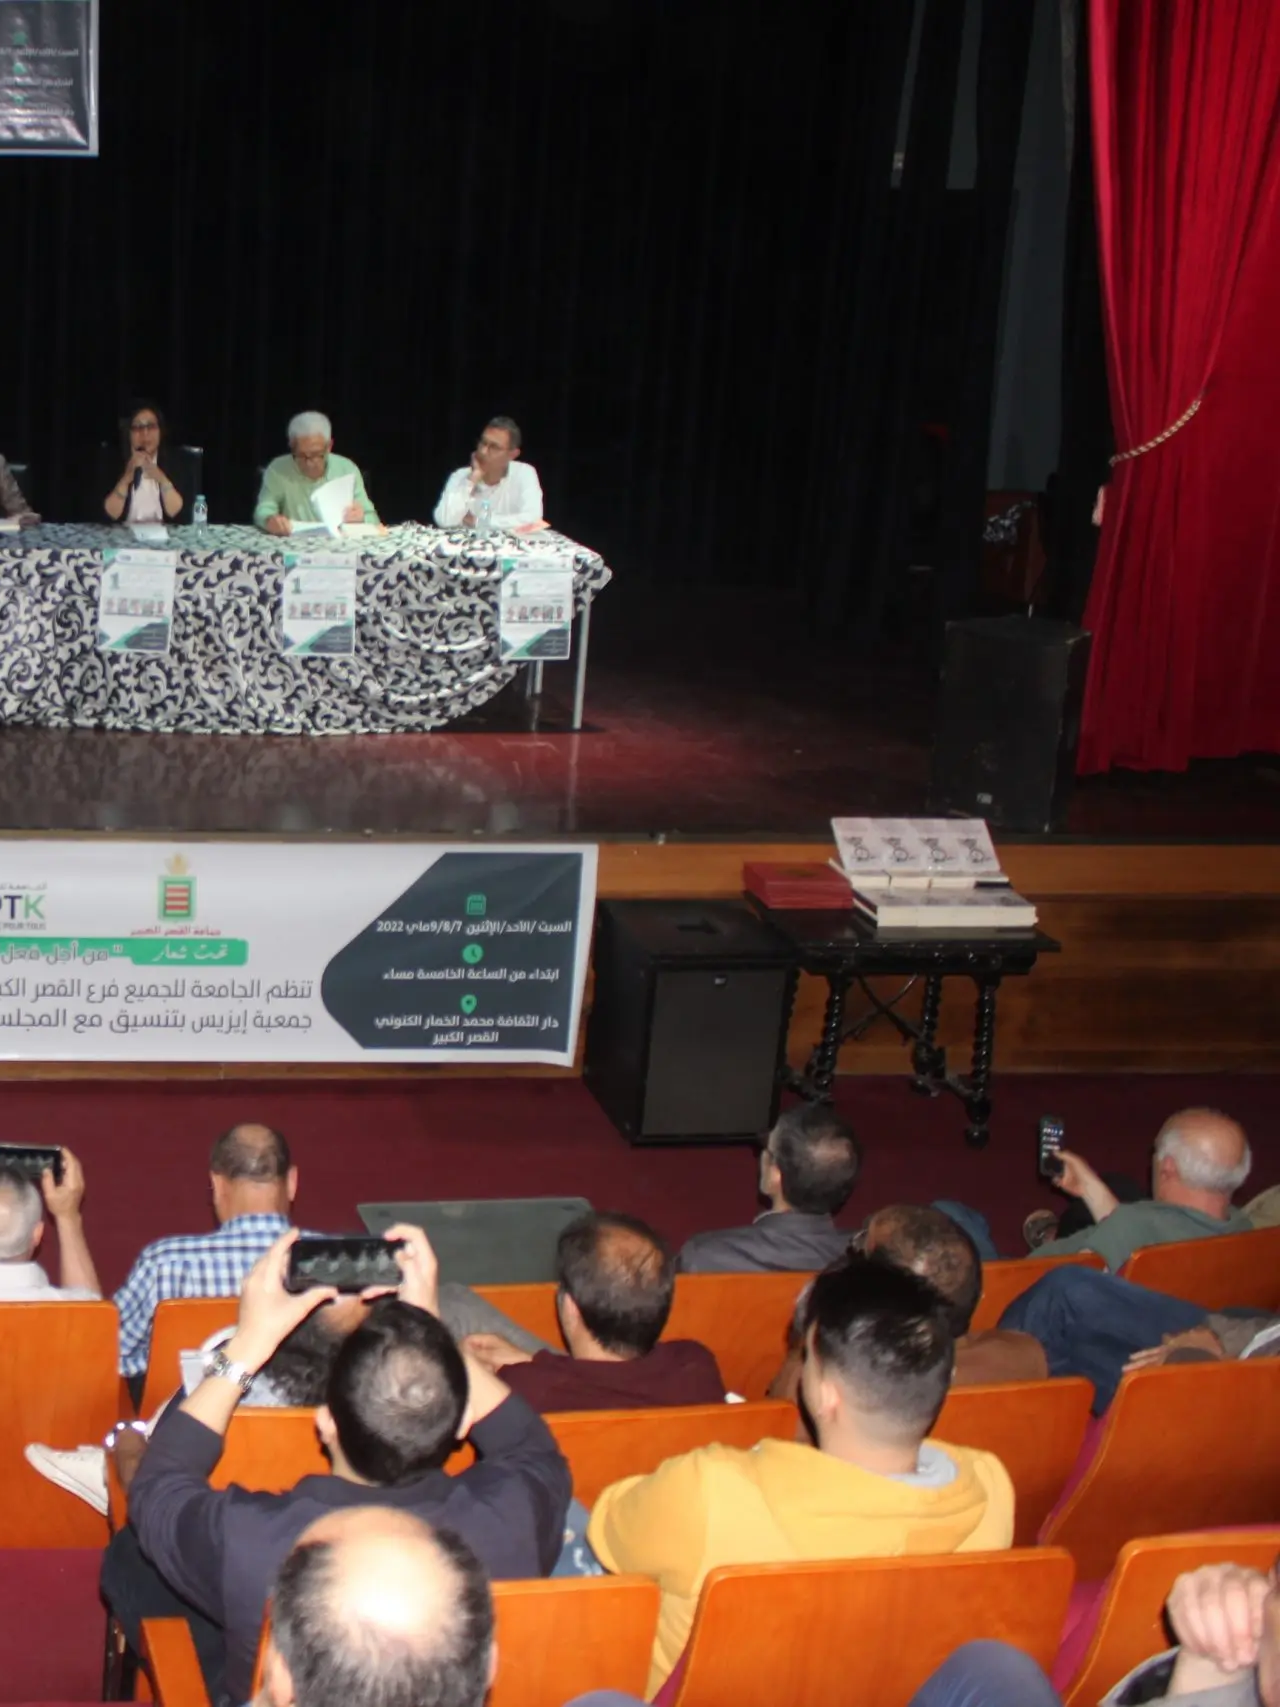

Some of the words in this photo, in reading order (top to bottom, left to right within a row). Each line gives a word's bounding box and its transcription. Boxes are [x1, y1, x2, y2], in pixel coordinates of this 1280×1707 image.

[377, 920, 404, 933] 2022
[539, 920, 572, 935] السبت
[46, 940, 78, 965] أجل
[383, 968, 414, 981] مساء
[417, 968, 465, 980] الخامسة
[468, 968, 507, 980] الساعة
[509, 972, 526, 982] من
[528, 968, 560, 981] ابتداء
[30, 978, 81, 1003] القصر
[86, 978, 119, 1003] فرع
[124, 978, 185, 1003] للجميع
[191, 979, 260, 1000] الجامعة
[266, 979, 313, 1003] تنظم
[73, 1013, 103, 1033] مع
[109, 1010, 186, 1035] بتنسيق
[191, 1009, 248, 1035] إيزيس
[252, 1012, 313, 1033] جمعية
[374, 1014, 422, 1030] الكنوني
[424, 1014, 459, 1030] الخمار
[463, 1016, 494, 1028] محمد
[497, 1014, 538, 1028] الثقافة
[541, 1016, 559, 1030] دار
[432, 1031, 464, 1046] الكبير
[466, 1031, 499, 1046] القصر
